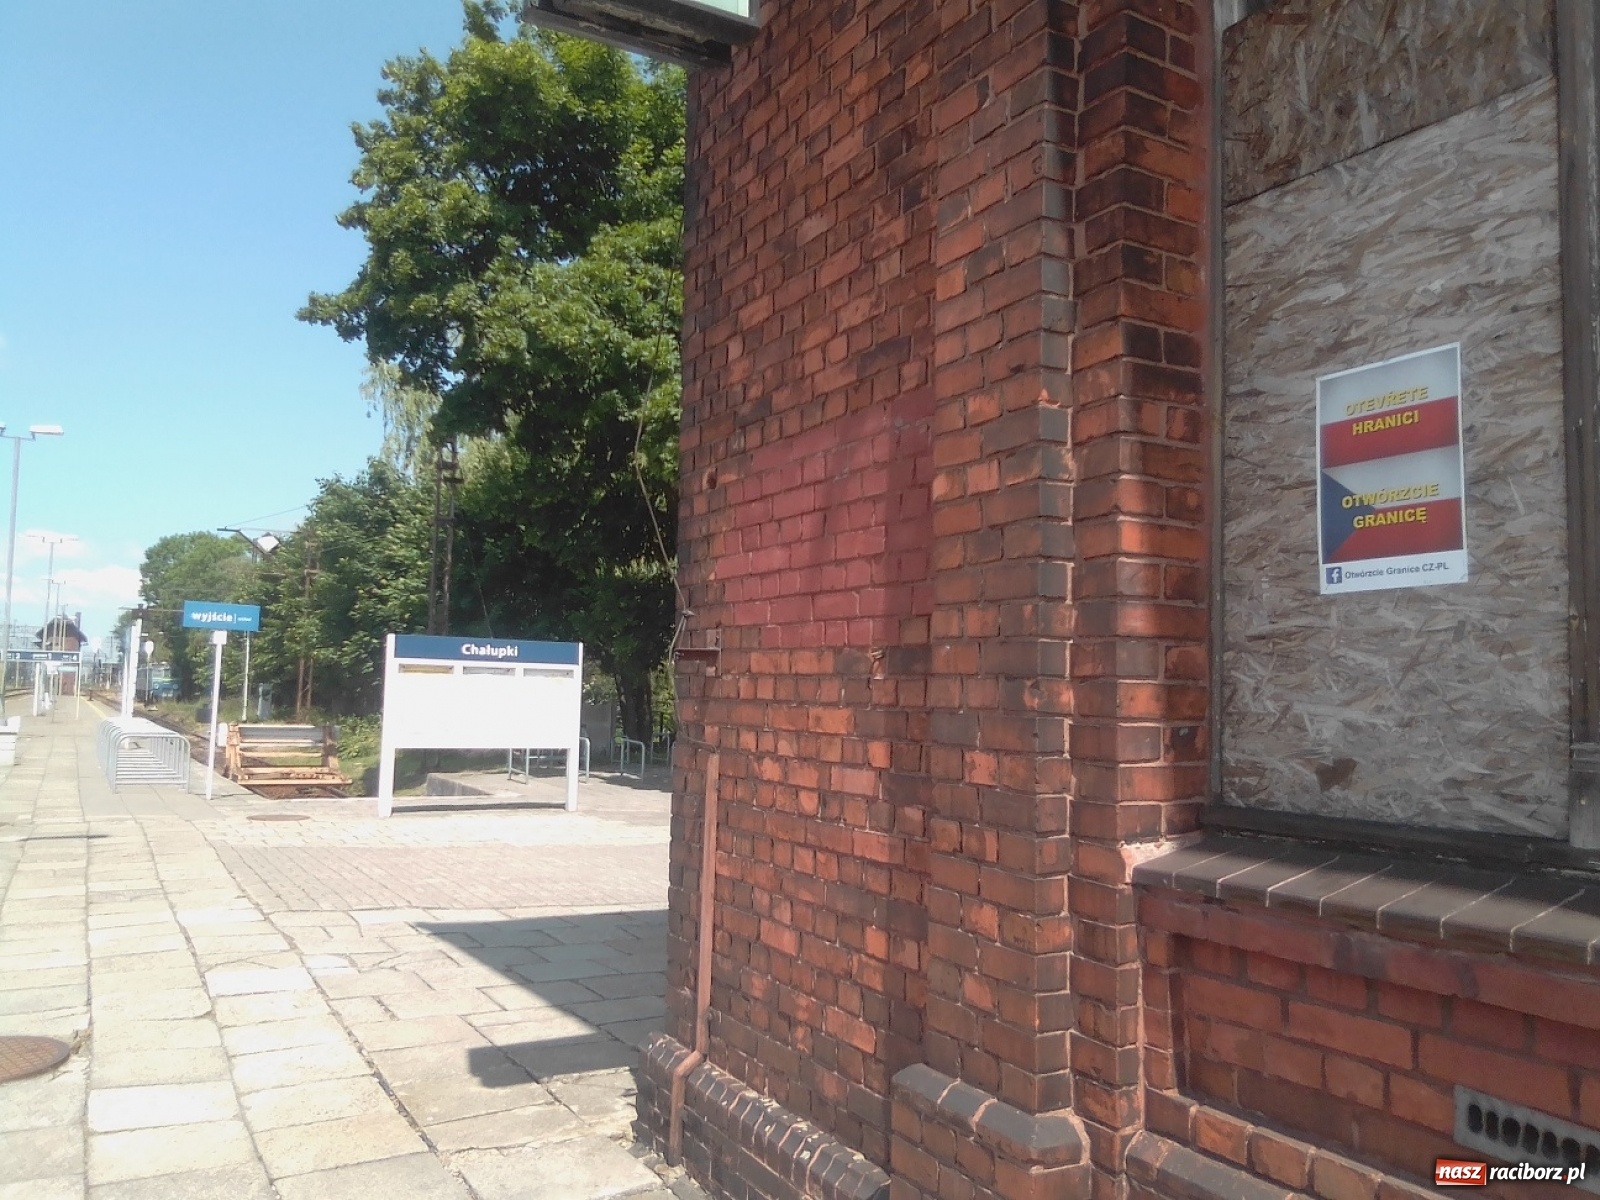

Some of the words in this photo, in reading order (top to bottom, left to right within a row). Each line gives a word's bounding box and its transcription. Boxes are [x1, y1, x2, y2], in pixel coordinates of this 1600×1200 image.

[1345, 386, 1430, 416] OTEVŘETE
[1352, 410, 1420, 436] HRANICI
[1341, 482, 1440, 509] OTWÓRZCIE
[1352, 506, 1428, 529] GRANICĘ
[1345, 567, 1384, 580] Otwórzcie
[1386, 565, 1420, 575] Granice
[1422, 562, 1450, 573] CZ-PL
[191, 611, 233, 623] wyjście
[461, 643, 519, 659] Chałupki
